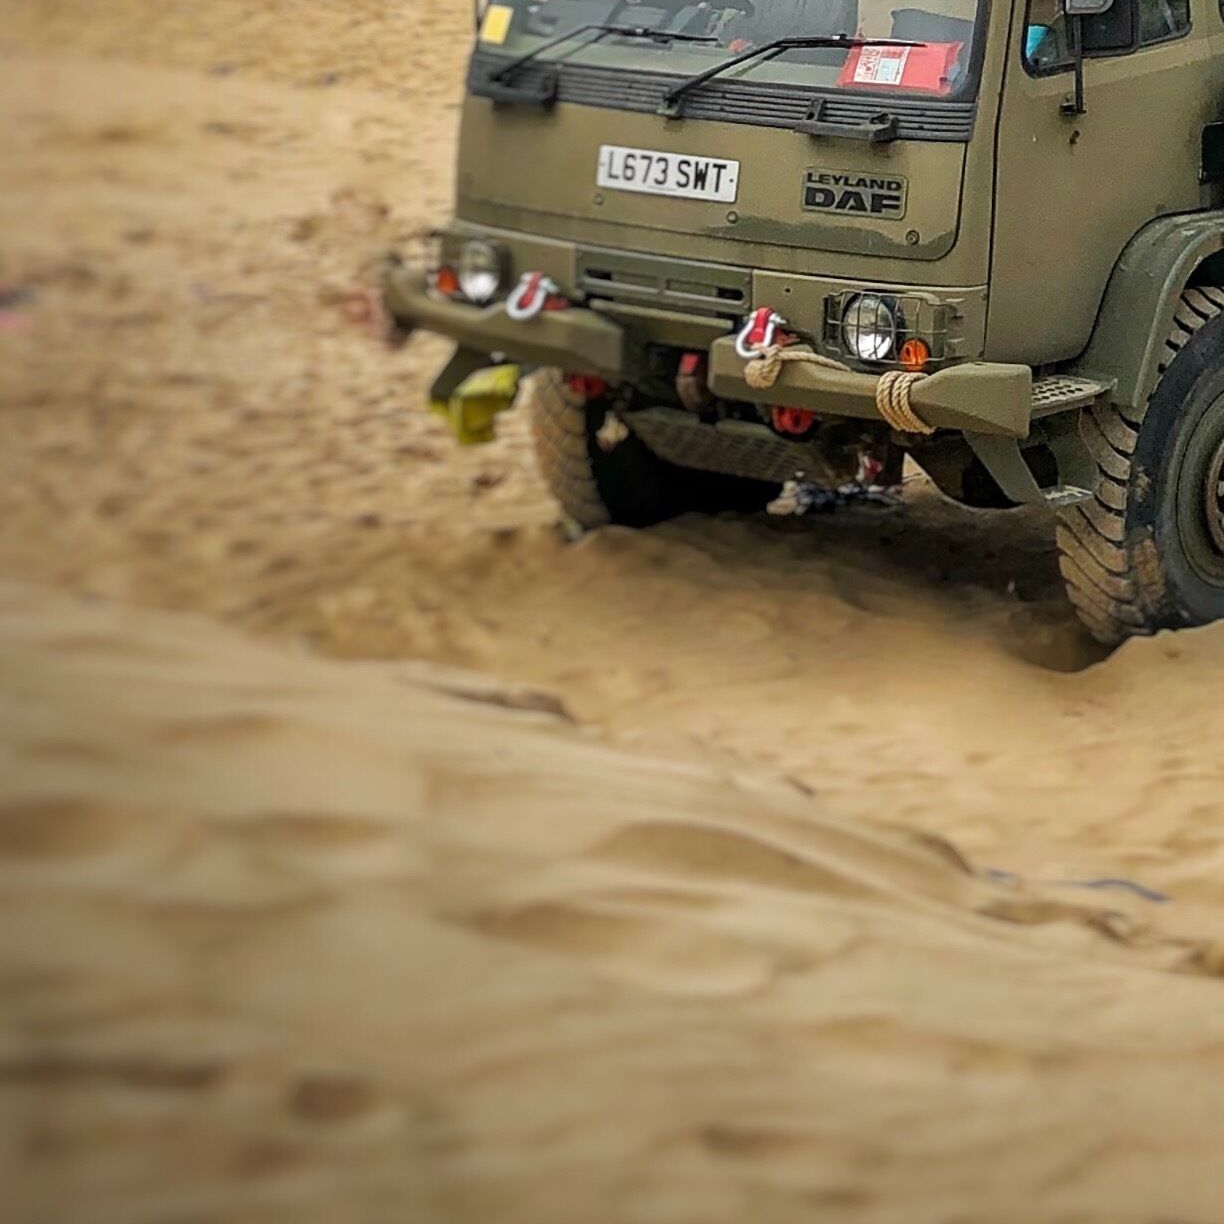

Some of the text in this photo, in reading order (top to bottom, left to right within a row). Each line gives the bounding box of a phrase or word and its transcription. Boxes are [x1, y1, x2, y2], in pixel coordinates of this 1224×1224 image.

[607, 150, 728, 193] L673 SWT
[806, 172, 901, 192] LEYLAND
[804, 187, 901, 214] DAF
